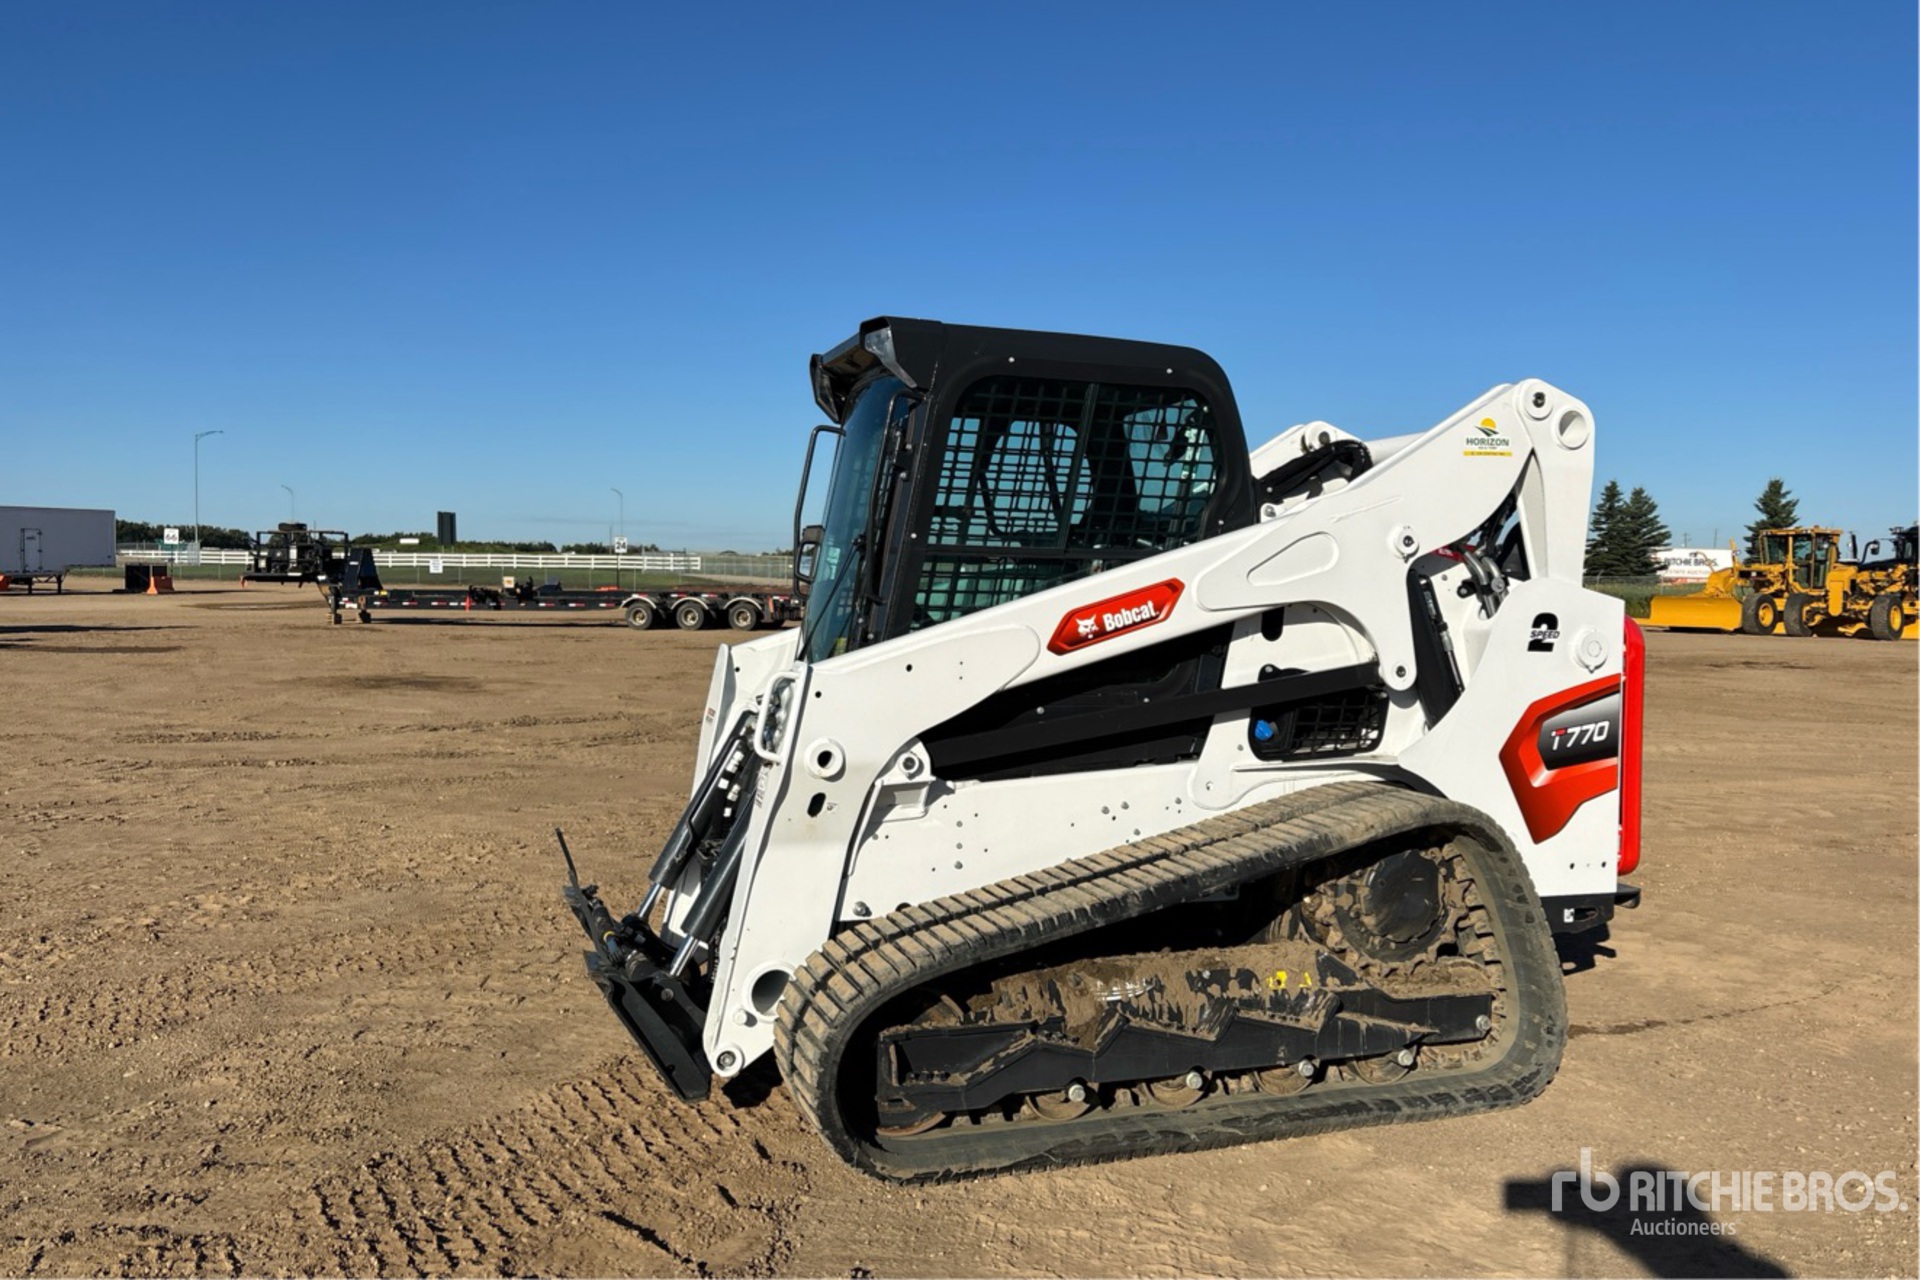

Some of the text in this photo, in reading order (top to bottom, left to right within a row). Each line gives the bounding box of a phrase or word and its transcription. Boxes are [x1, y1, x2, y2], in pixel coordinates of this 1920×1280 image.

[1466, 438, 1510, 447] HORIZON
[1103, 600, 1156, 632] Bobcat
[1527, 612, 1559, 652] 2
[1530, 630, 1560, 639] SPEED
[1551, 720, 1610, 750] T770
